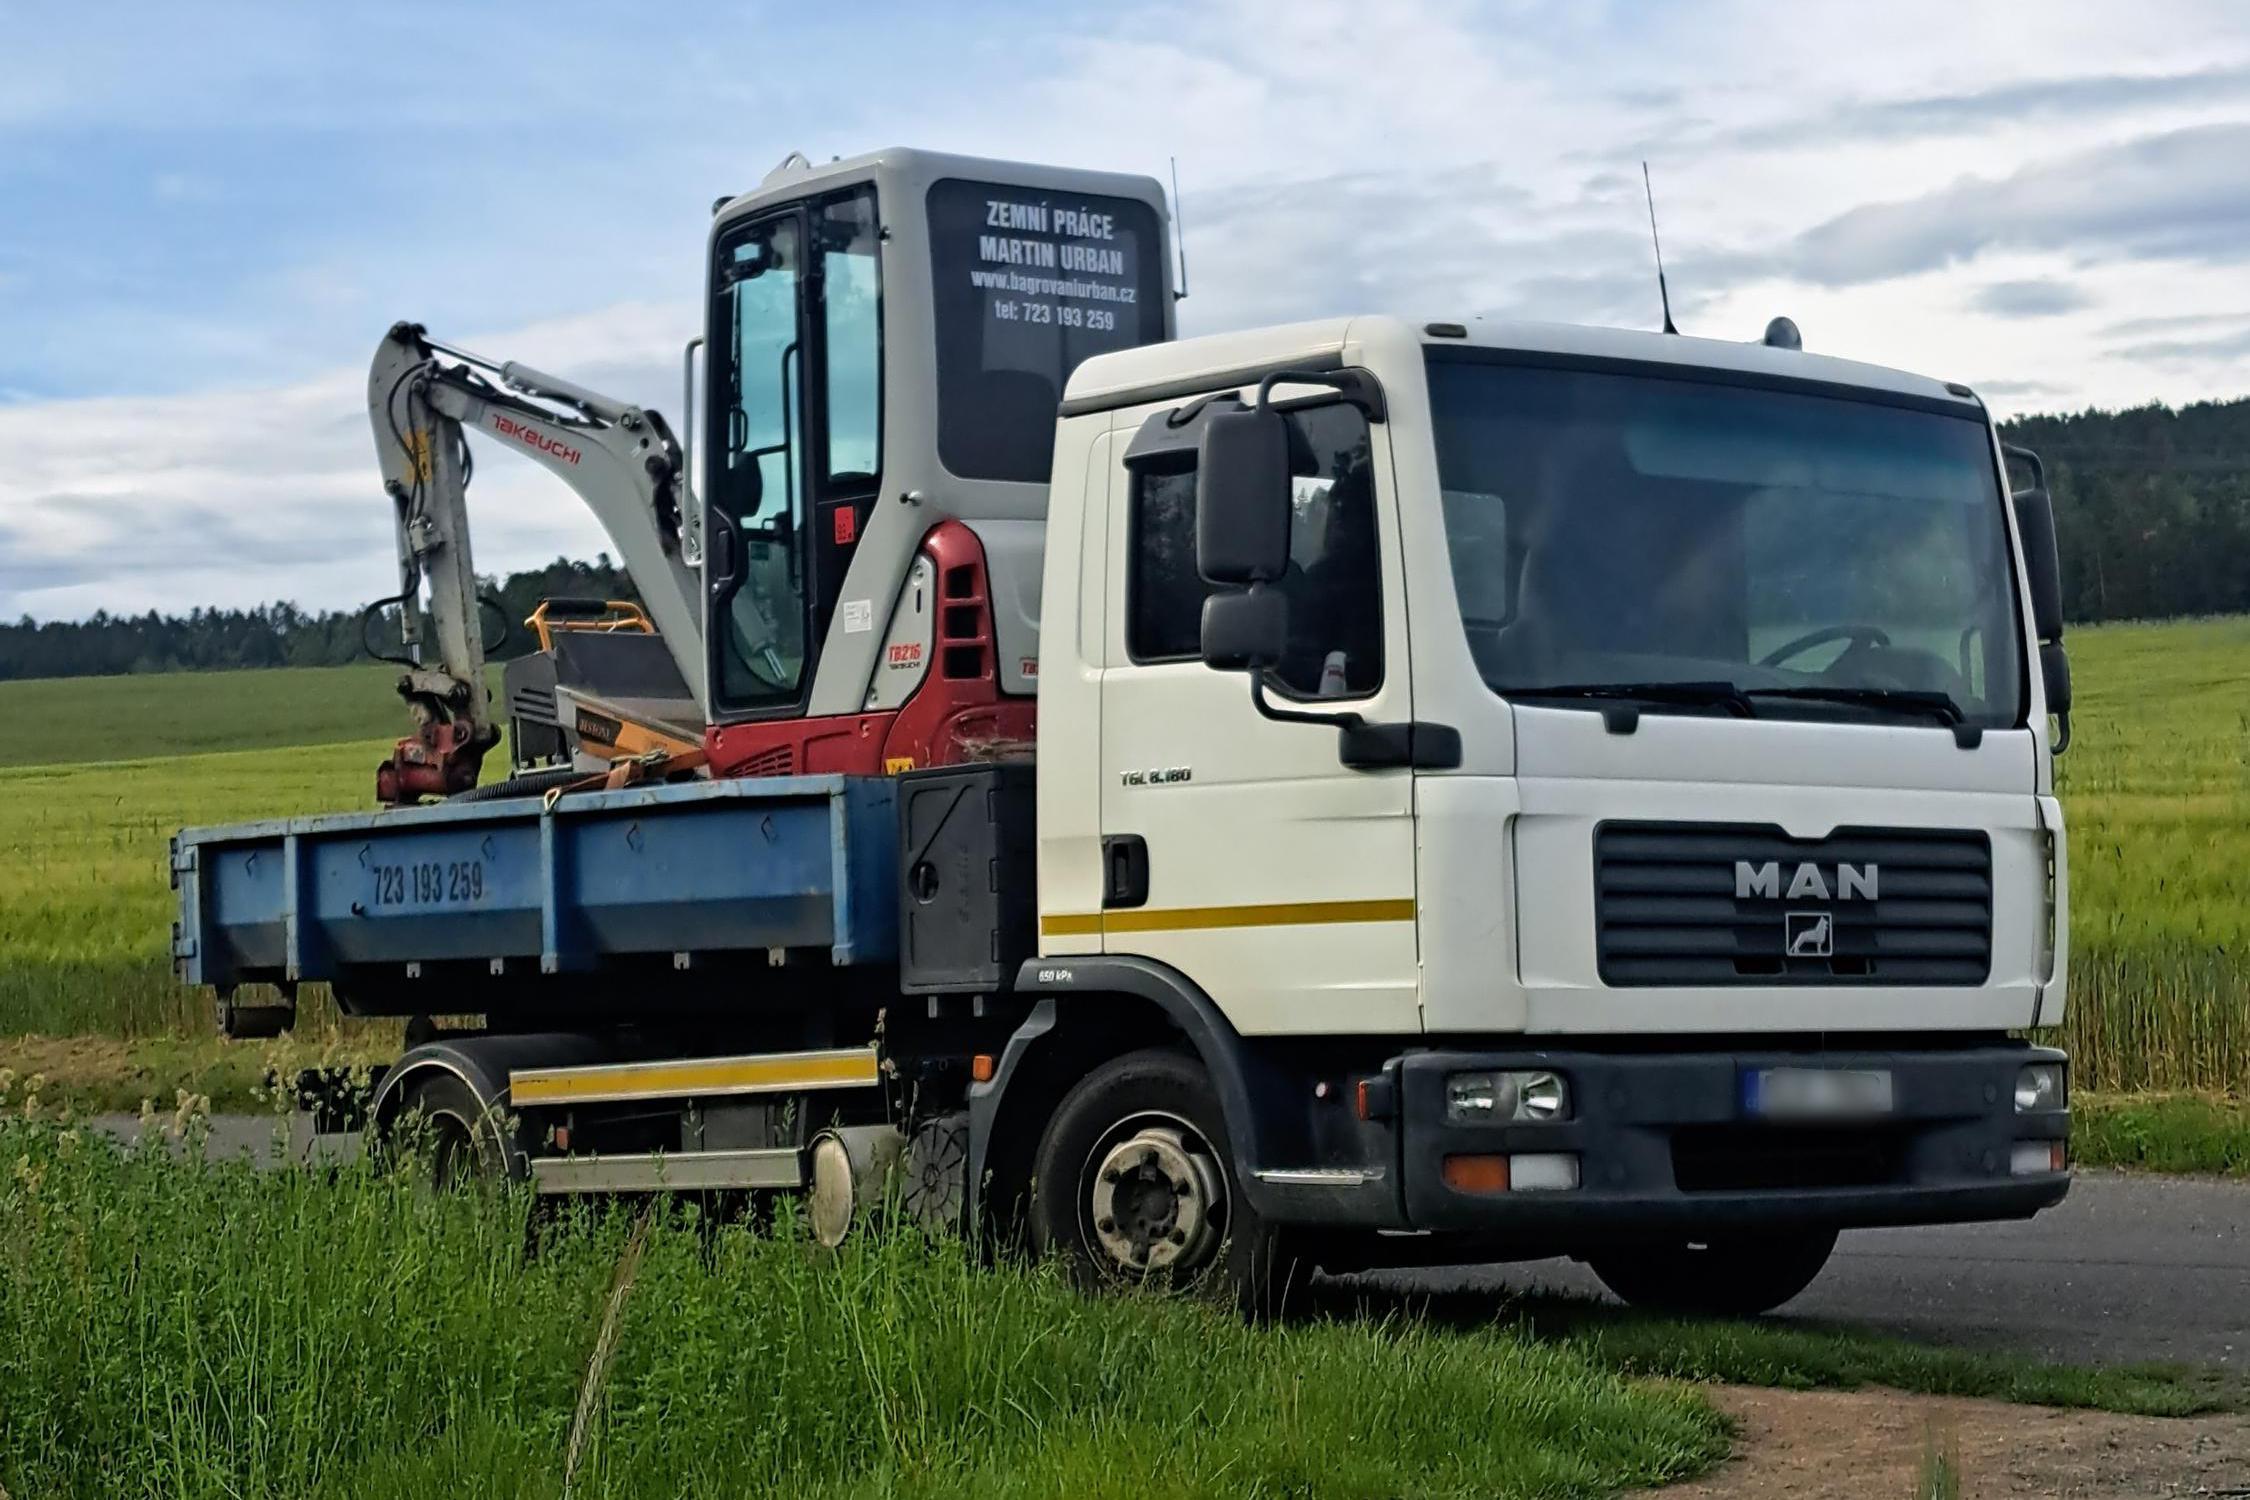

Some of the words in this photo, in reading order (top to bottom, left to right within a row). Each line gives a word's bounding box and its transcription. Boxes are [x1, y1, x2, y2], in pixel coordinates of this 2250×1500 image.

[986, 200, 1048, 232] ZEMNÍ
[1053, 206, 1114, 240] PRÁCE
[979, 235, 1054, 267] MARTIN
[1060, 244, 1123, 275] URBAN
[994, 300, 1018, 320] tel:
[1021, 302, 1050, 324] 723
[1055, 306, 1082, 327] 193
[1086, 309, 1115, 331] 259
[1120, 769, 1147, 786] TGL
[1149, 765, 1192, 784] 8.180
[373, 865, 405, 906] 723
[412, 863, 443, 904] 193
[449, 861, 483, 902] 259
[1735, 860, 1879, 901] MAN
[1038, 969, 1055, 983] 650
